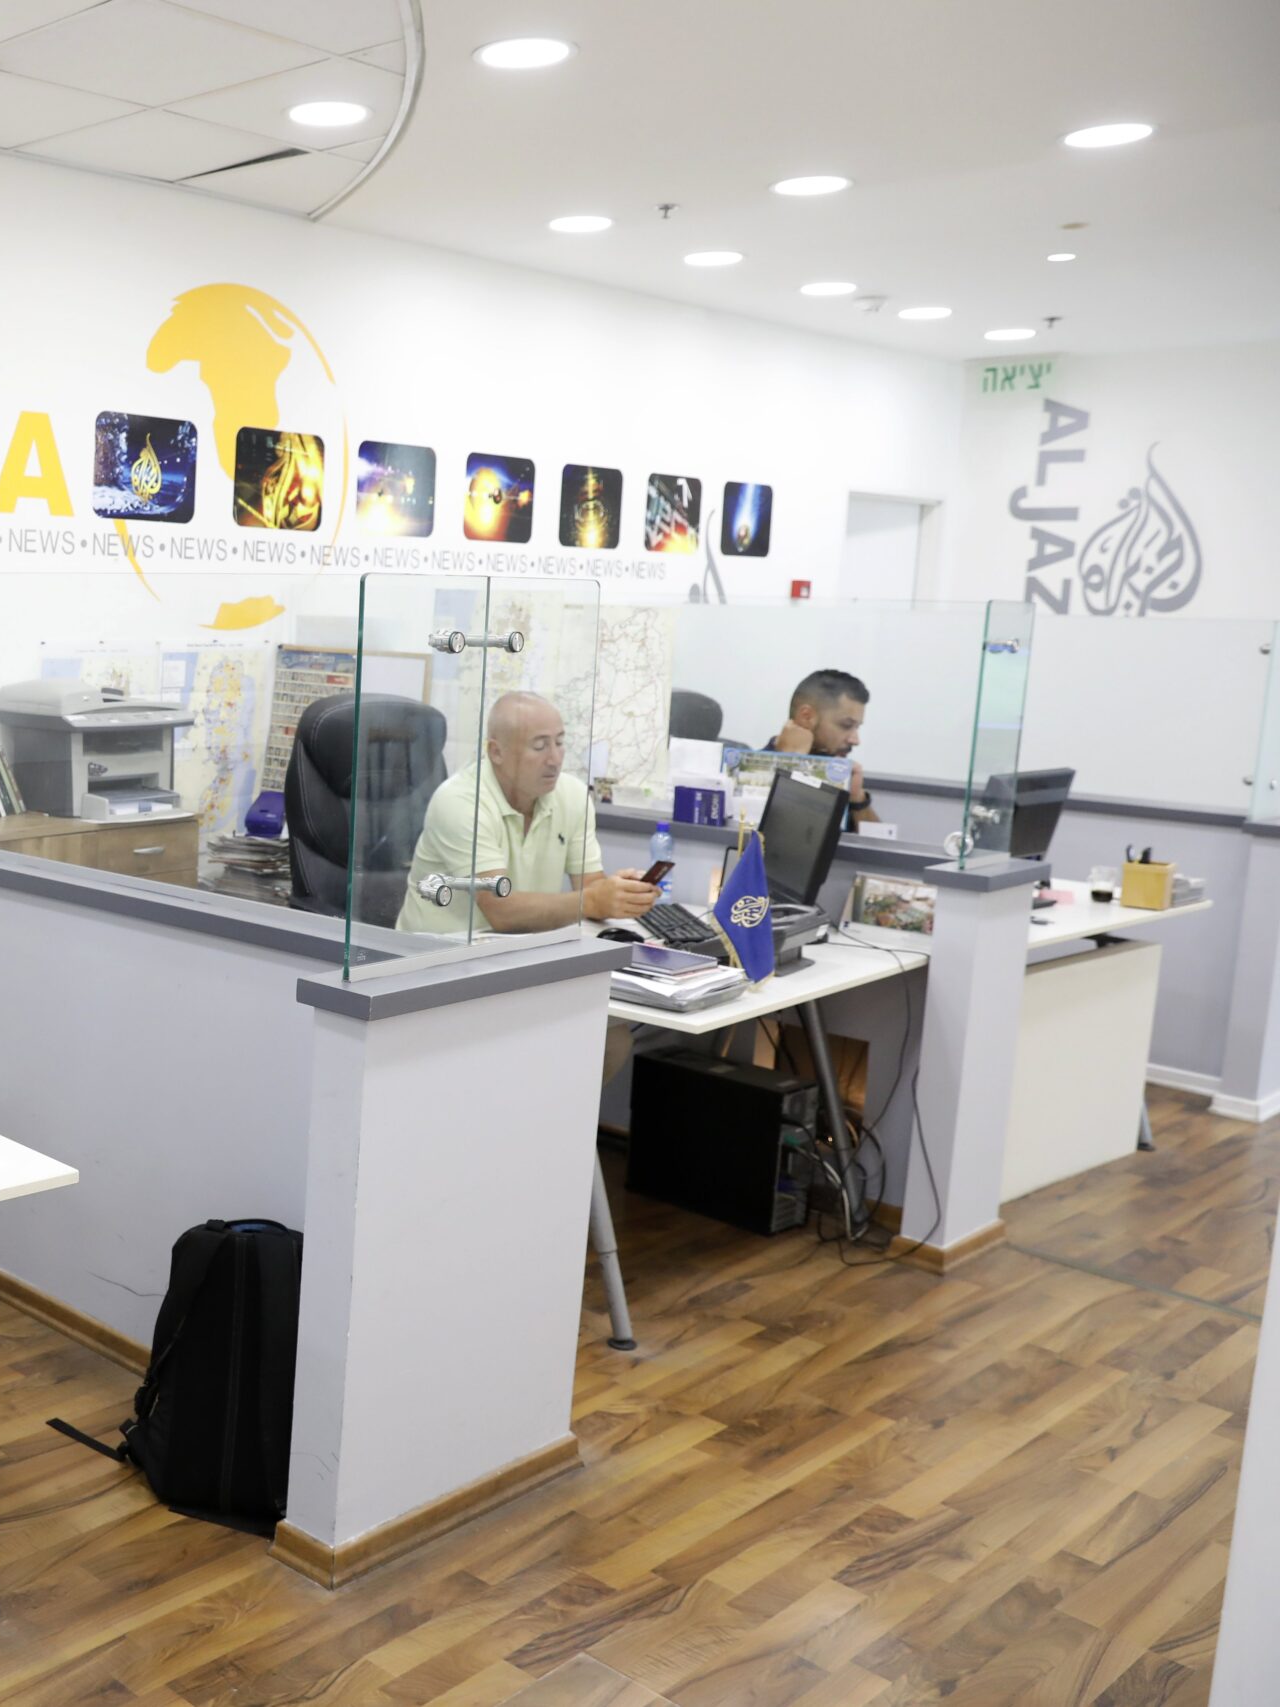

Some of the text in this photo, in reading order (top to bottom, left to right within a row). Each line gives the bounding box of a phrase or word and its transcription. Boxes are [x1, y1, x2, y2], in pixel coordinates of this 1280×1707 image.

[982, 362, 1052, 393] יציאה
[9, 528, 75, 555] NEWS
[92, 532, 154, 558] NEWS
[170, 536, 227, 561] NEWS
[242, 540, 296, 564] NEWS
[310, 544, 360, 568] NEWS
[372, 547, 420, 569] NEWS
[431, 550, 475, 571] NEWS
[486, 553, 527, 573] NEWS
[537, 556, 576, 576] NEWS
[585, 558, 622, 578] NEWS
[631, 561, 665, 580] NEWS
